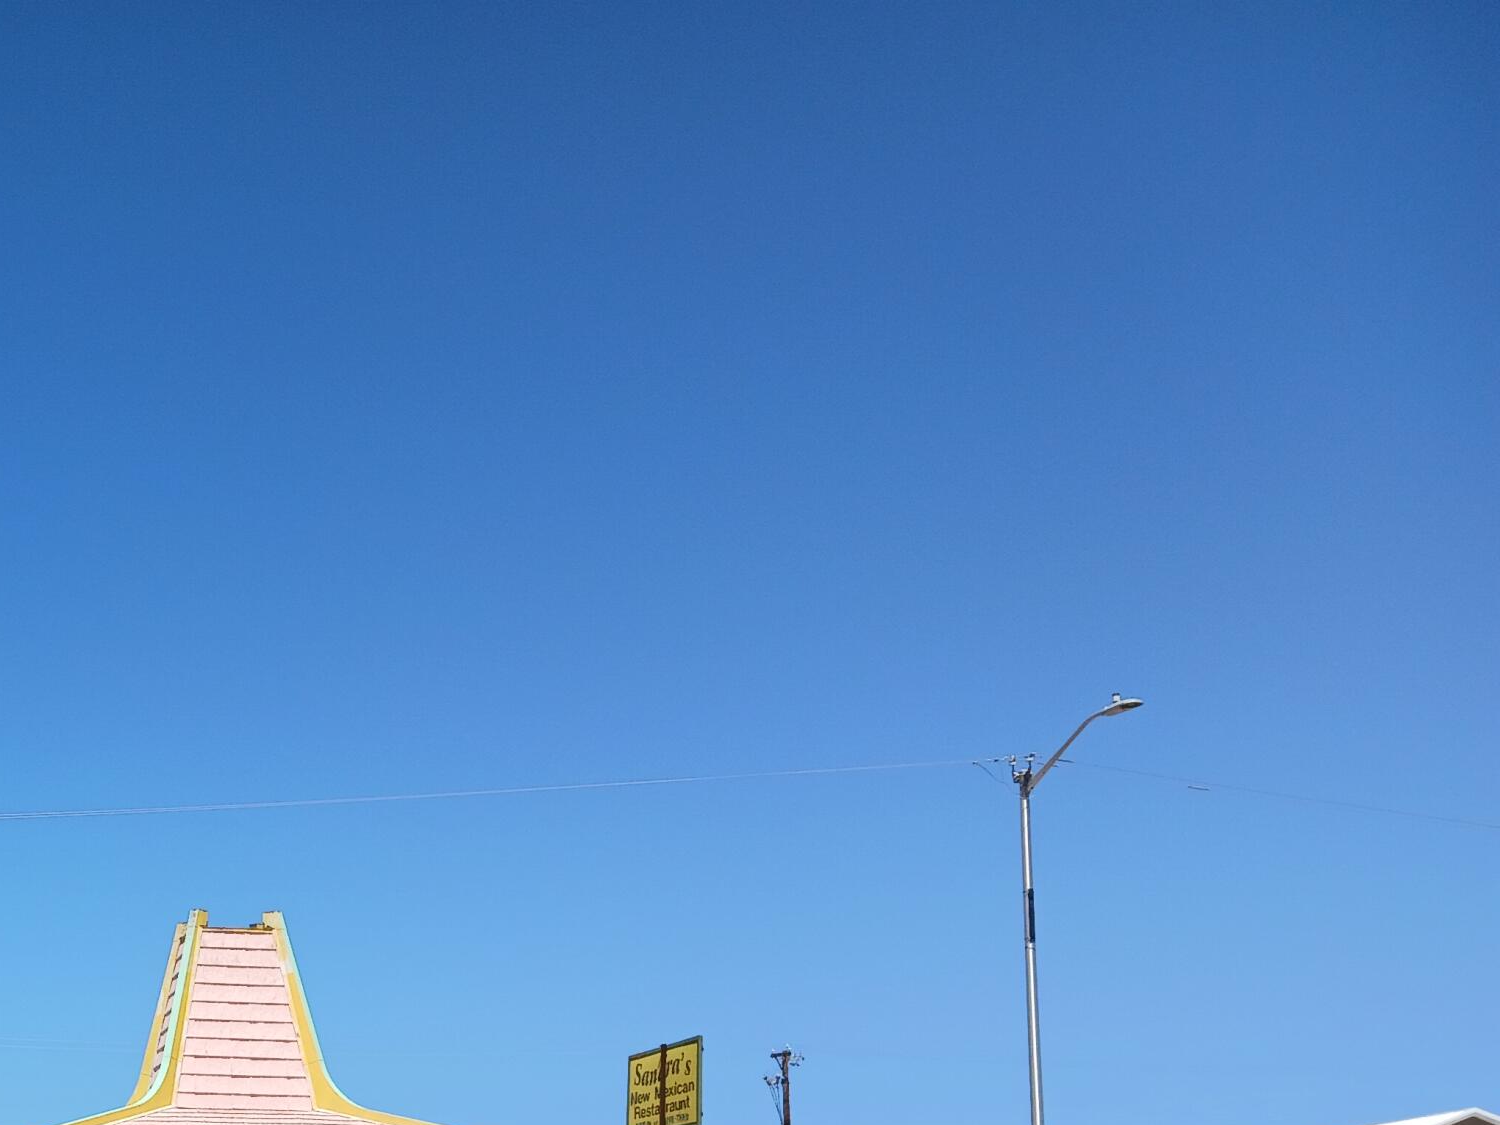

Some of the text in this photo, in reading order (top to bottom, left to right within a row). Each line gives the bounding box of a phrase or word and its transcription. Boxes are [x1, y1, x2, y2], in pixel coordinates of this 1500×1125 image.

[631, 1081, 695, 1106] New Mexican
[634, 1095, 690, 1120] Restaraunt
